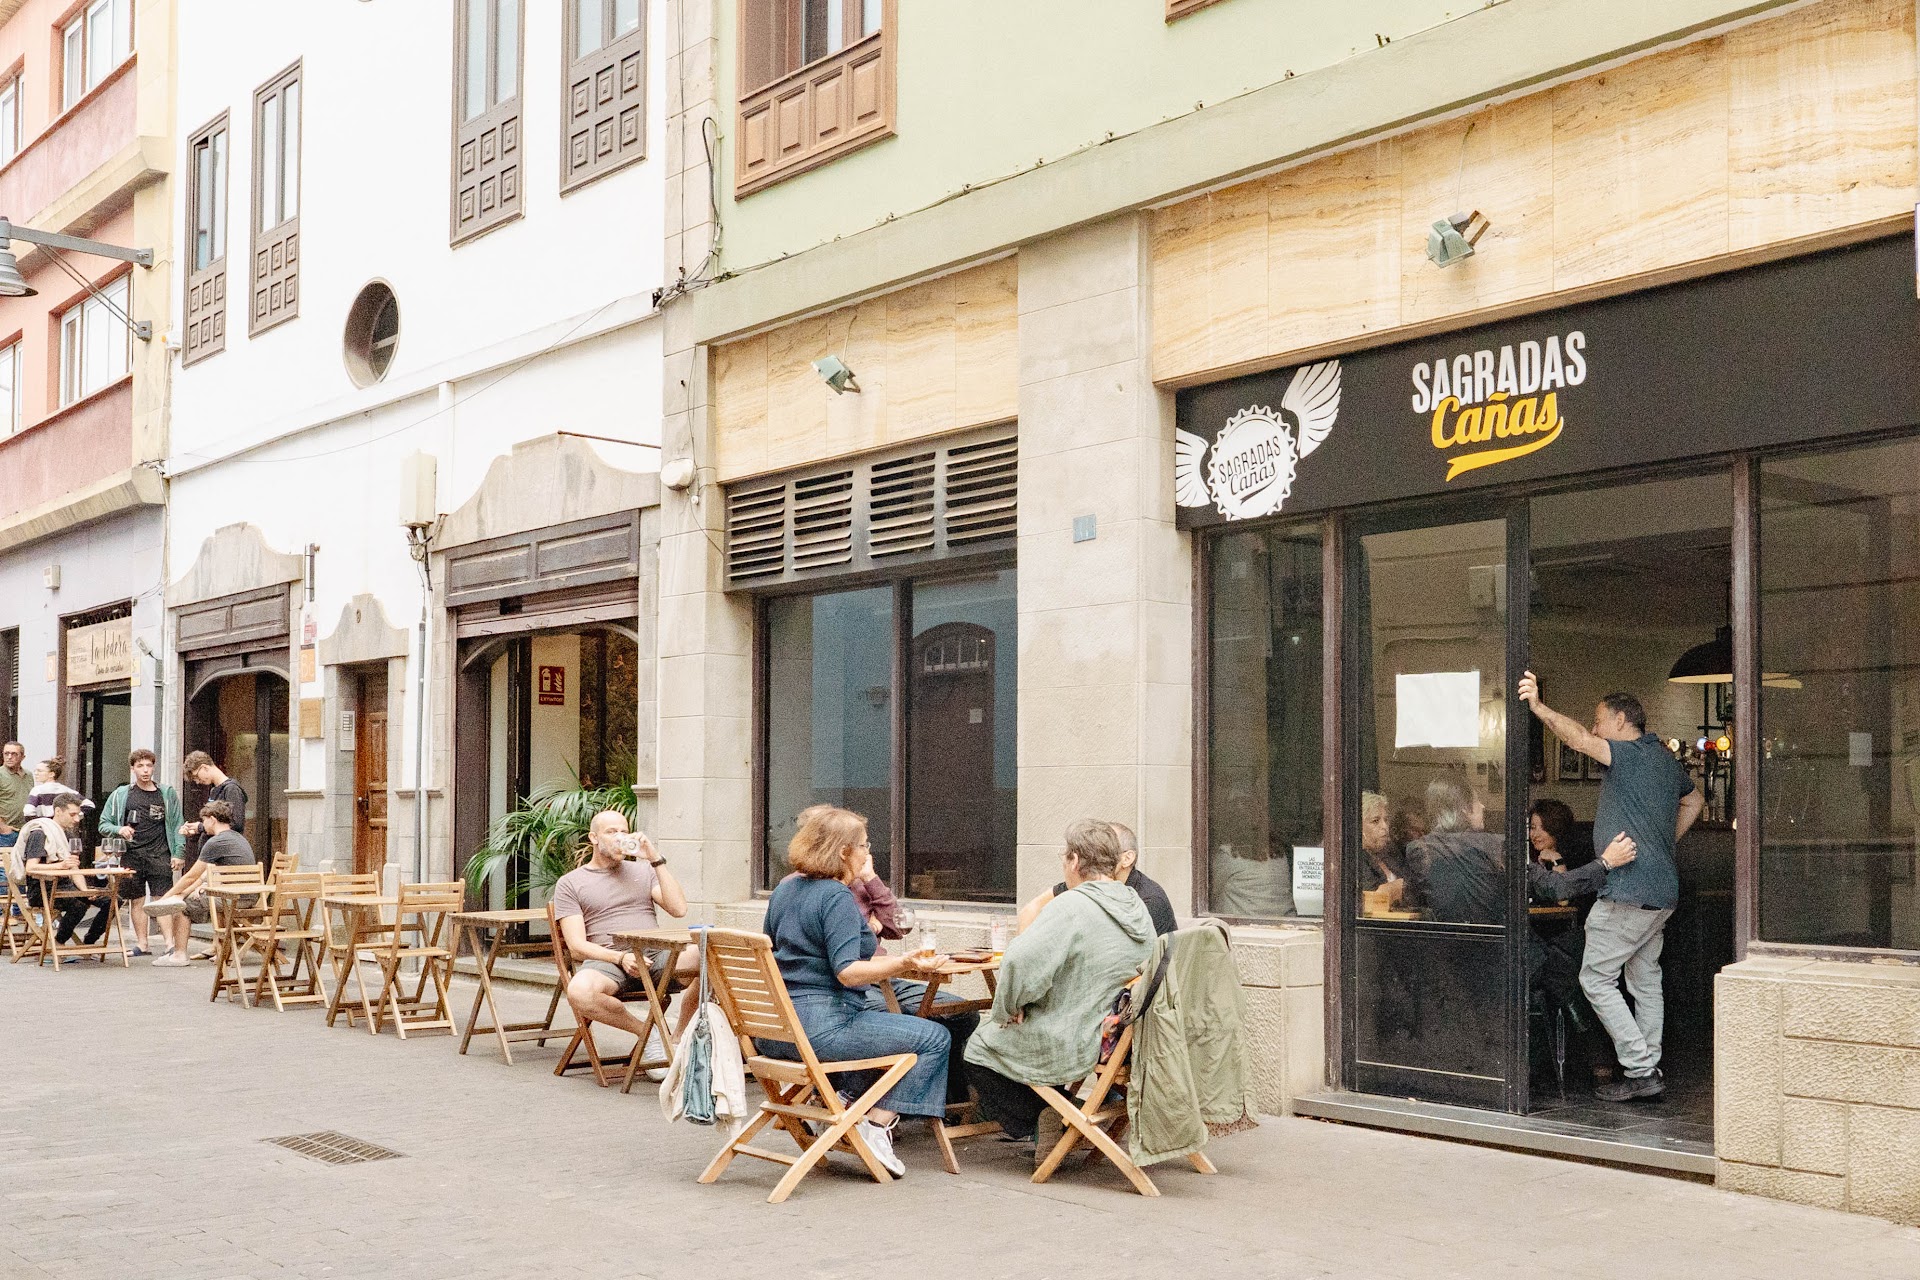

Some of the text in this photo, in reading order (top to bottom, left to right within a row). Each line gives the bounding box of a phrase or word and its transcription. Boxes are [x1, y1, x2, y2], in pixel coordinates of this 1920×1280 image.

[1412, 331, 1587, 414] SAGRADAS
[1431, 392, 1558, 449] Cañas
[1218, 435, 1281, 484] SAGRADAS
[1230, 461, 1276, 496] Cañas
